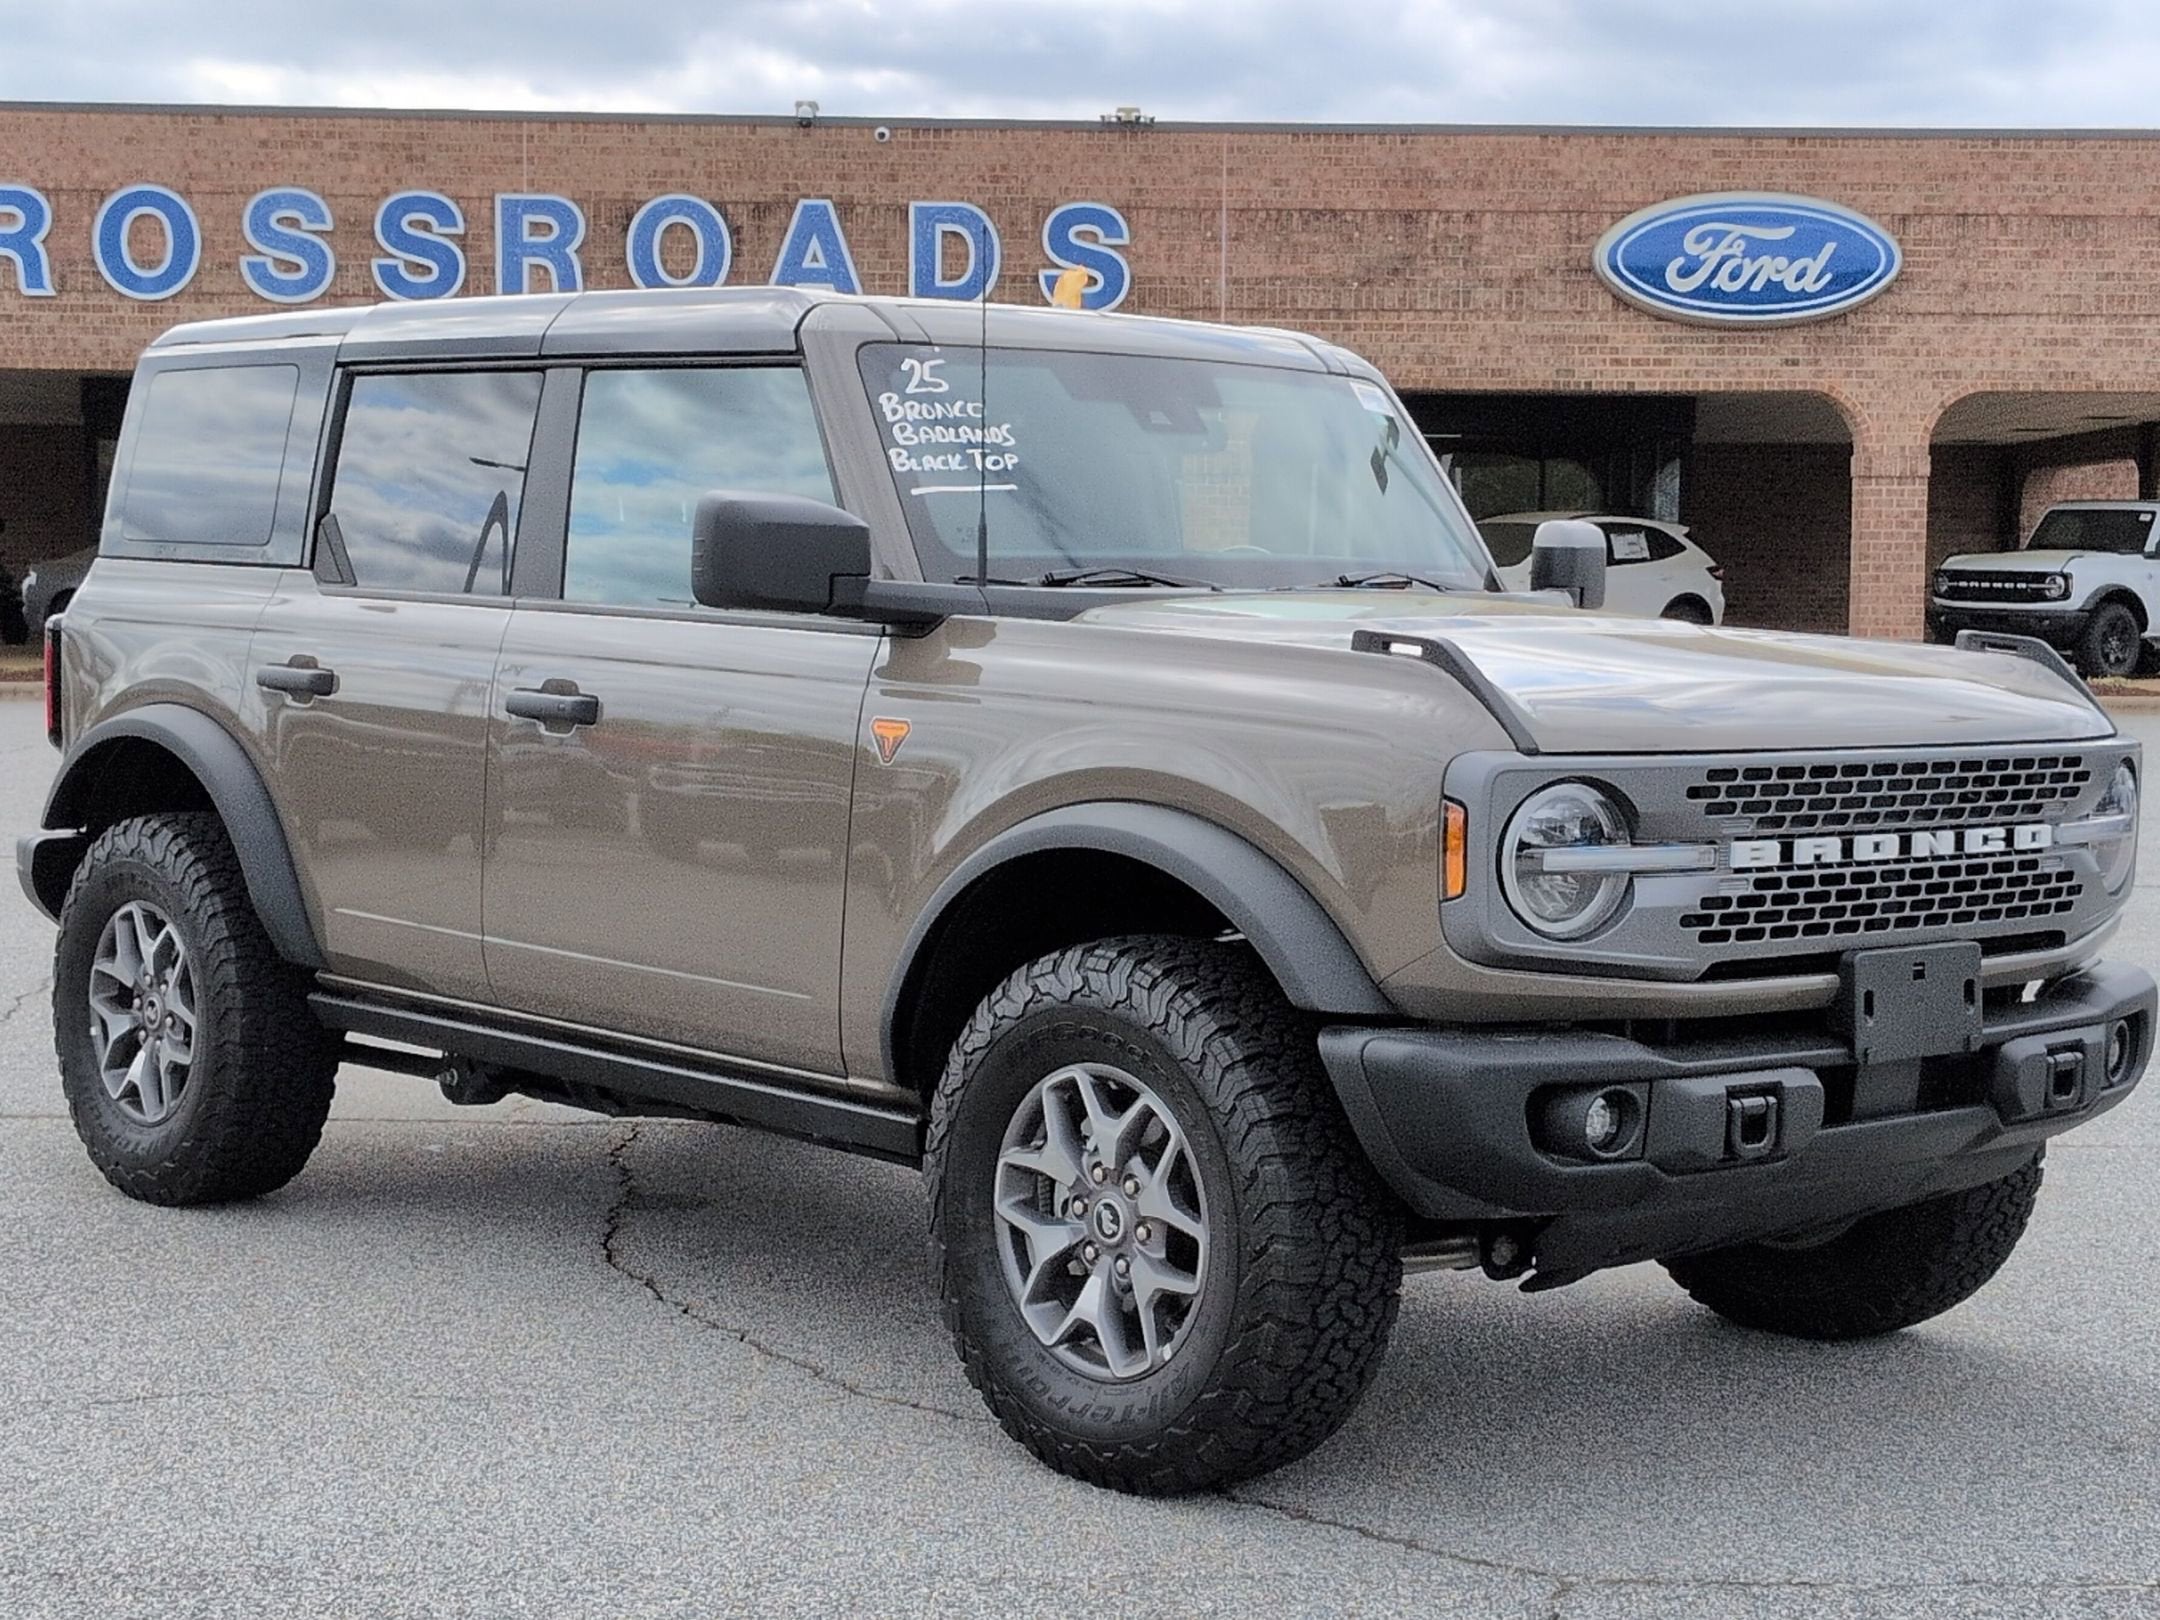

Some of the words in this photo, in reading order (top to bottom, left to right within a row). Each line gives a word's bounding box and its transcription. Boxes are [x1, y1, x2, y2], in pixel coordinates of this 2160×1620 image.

[1665, 222, 1838, 293] Ford
[900, 358, 949, 394] 25
[892, 422, 1016, 446] BADLANDS
[888, 448, 969, 472] BLACK
[966, 448, 1019, 471] TOP
[1729, 823, 2053, 869] BRONCO
